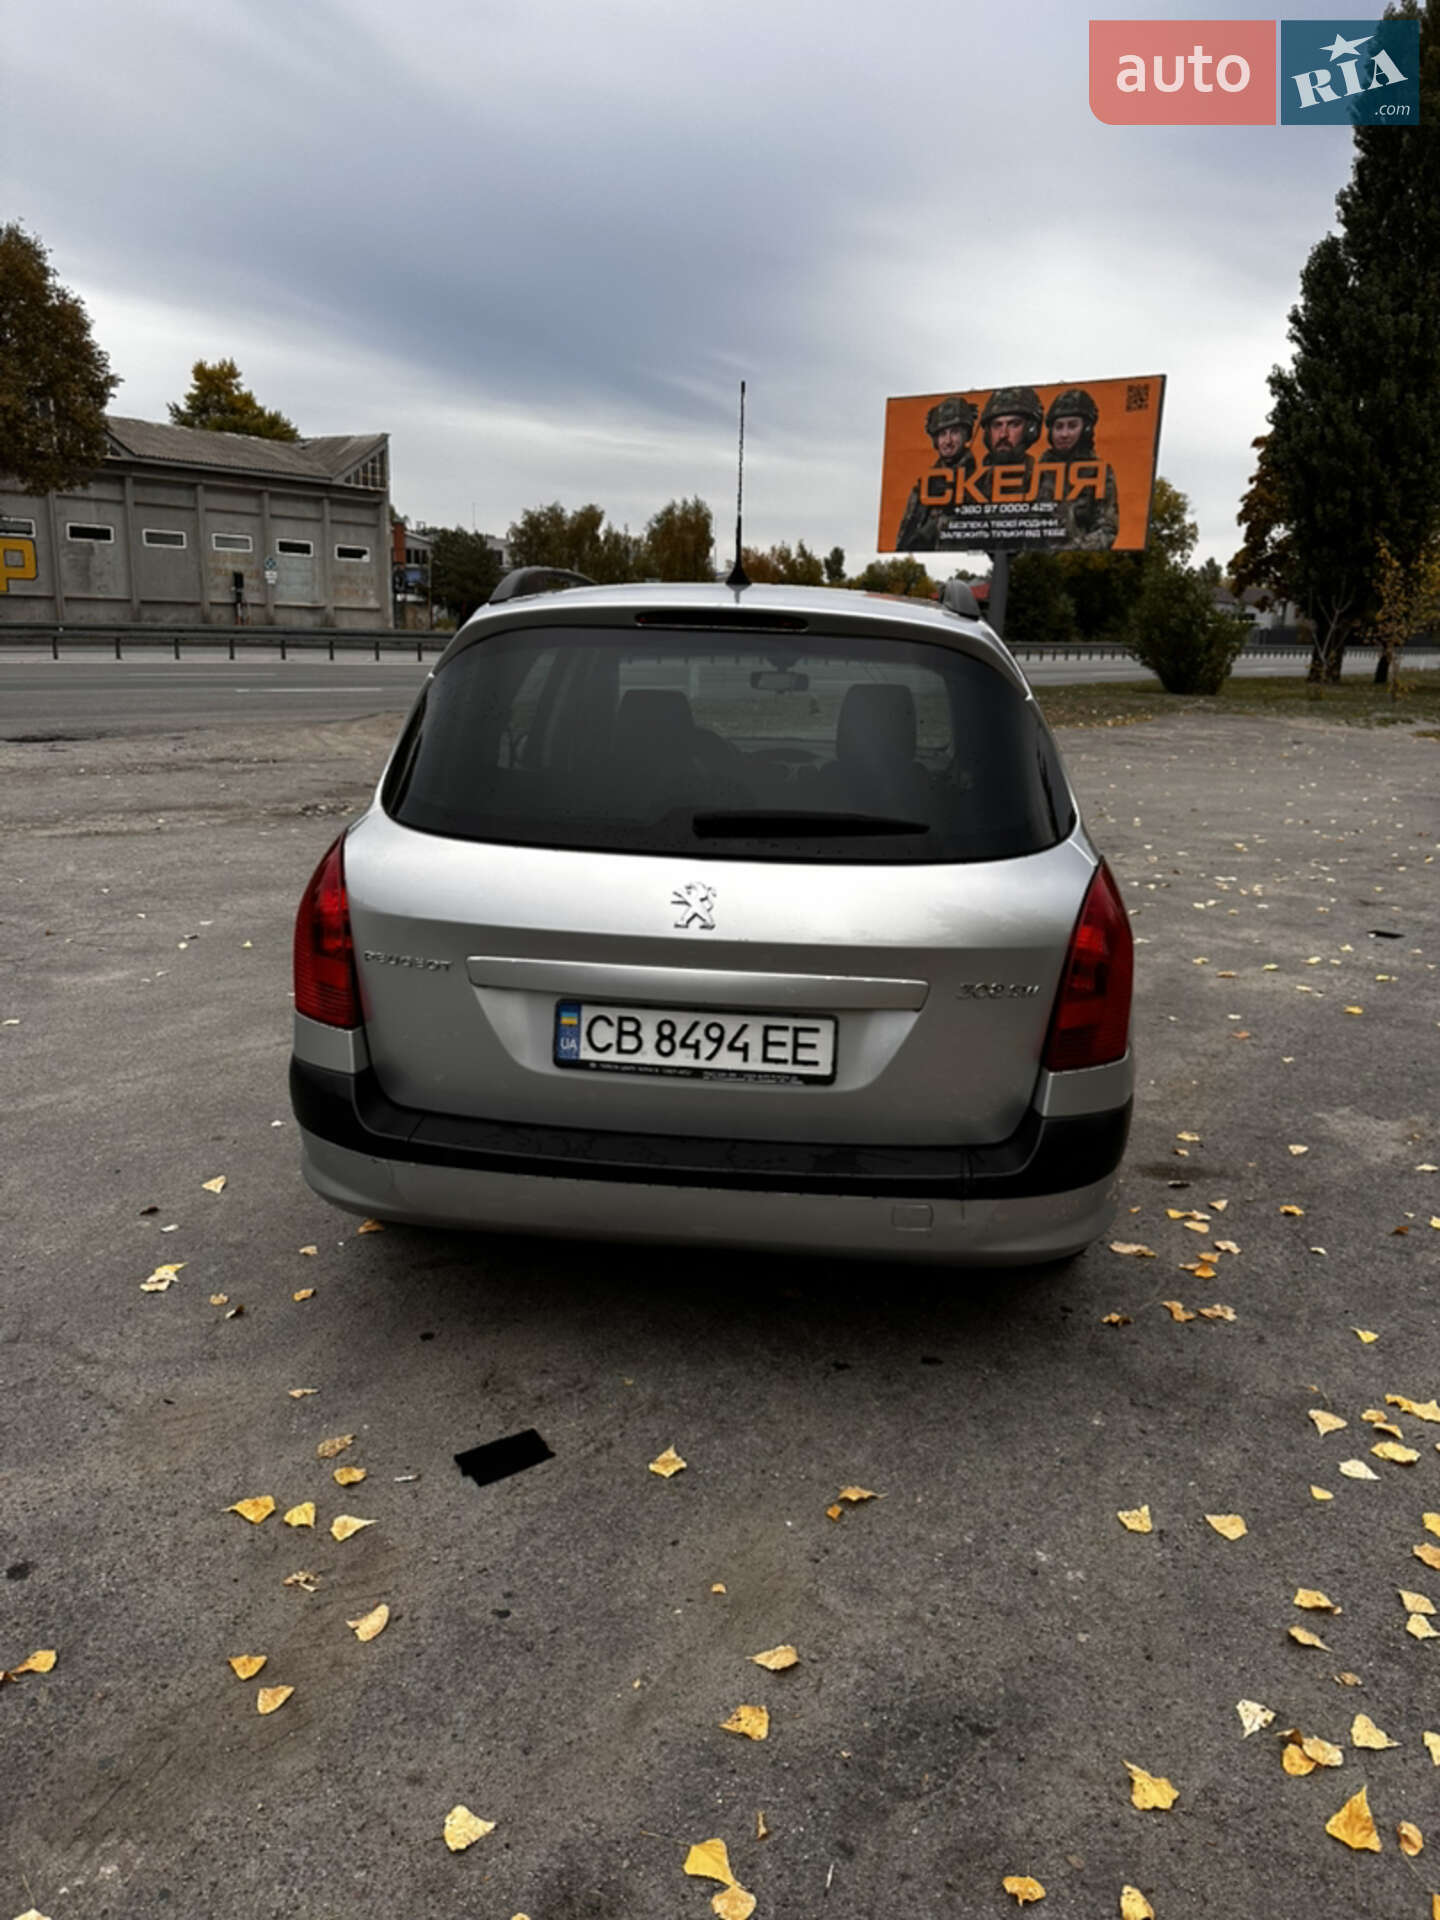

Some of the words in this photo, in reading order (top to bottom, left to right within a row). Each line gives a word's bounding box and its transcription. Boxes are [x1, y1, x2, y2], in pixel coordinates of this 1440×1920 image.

[920, 461, 1107, 506] СКЕЛЯ
[999, 503, 1030, 513] 0000
[560, 1037, 578, 1051] UA
[586, 1014, 643, 1055] CB
[655, 1018, 750, 1063] 8494
[762, 1024, 821, 1067] EE
